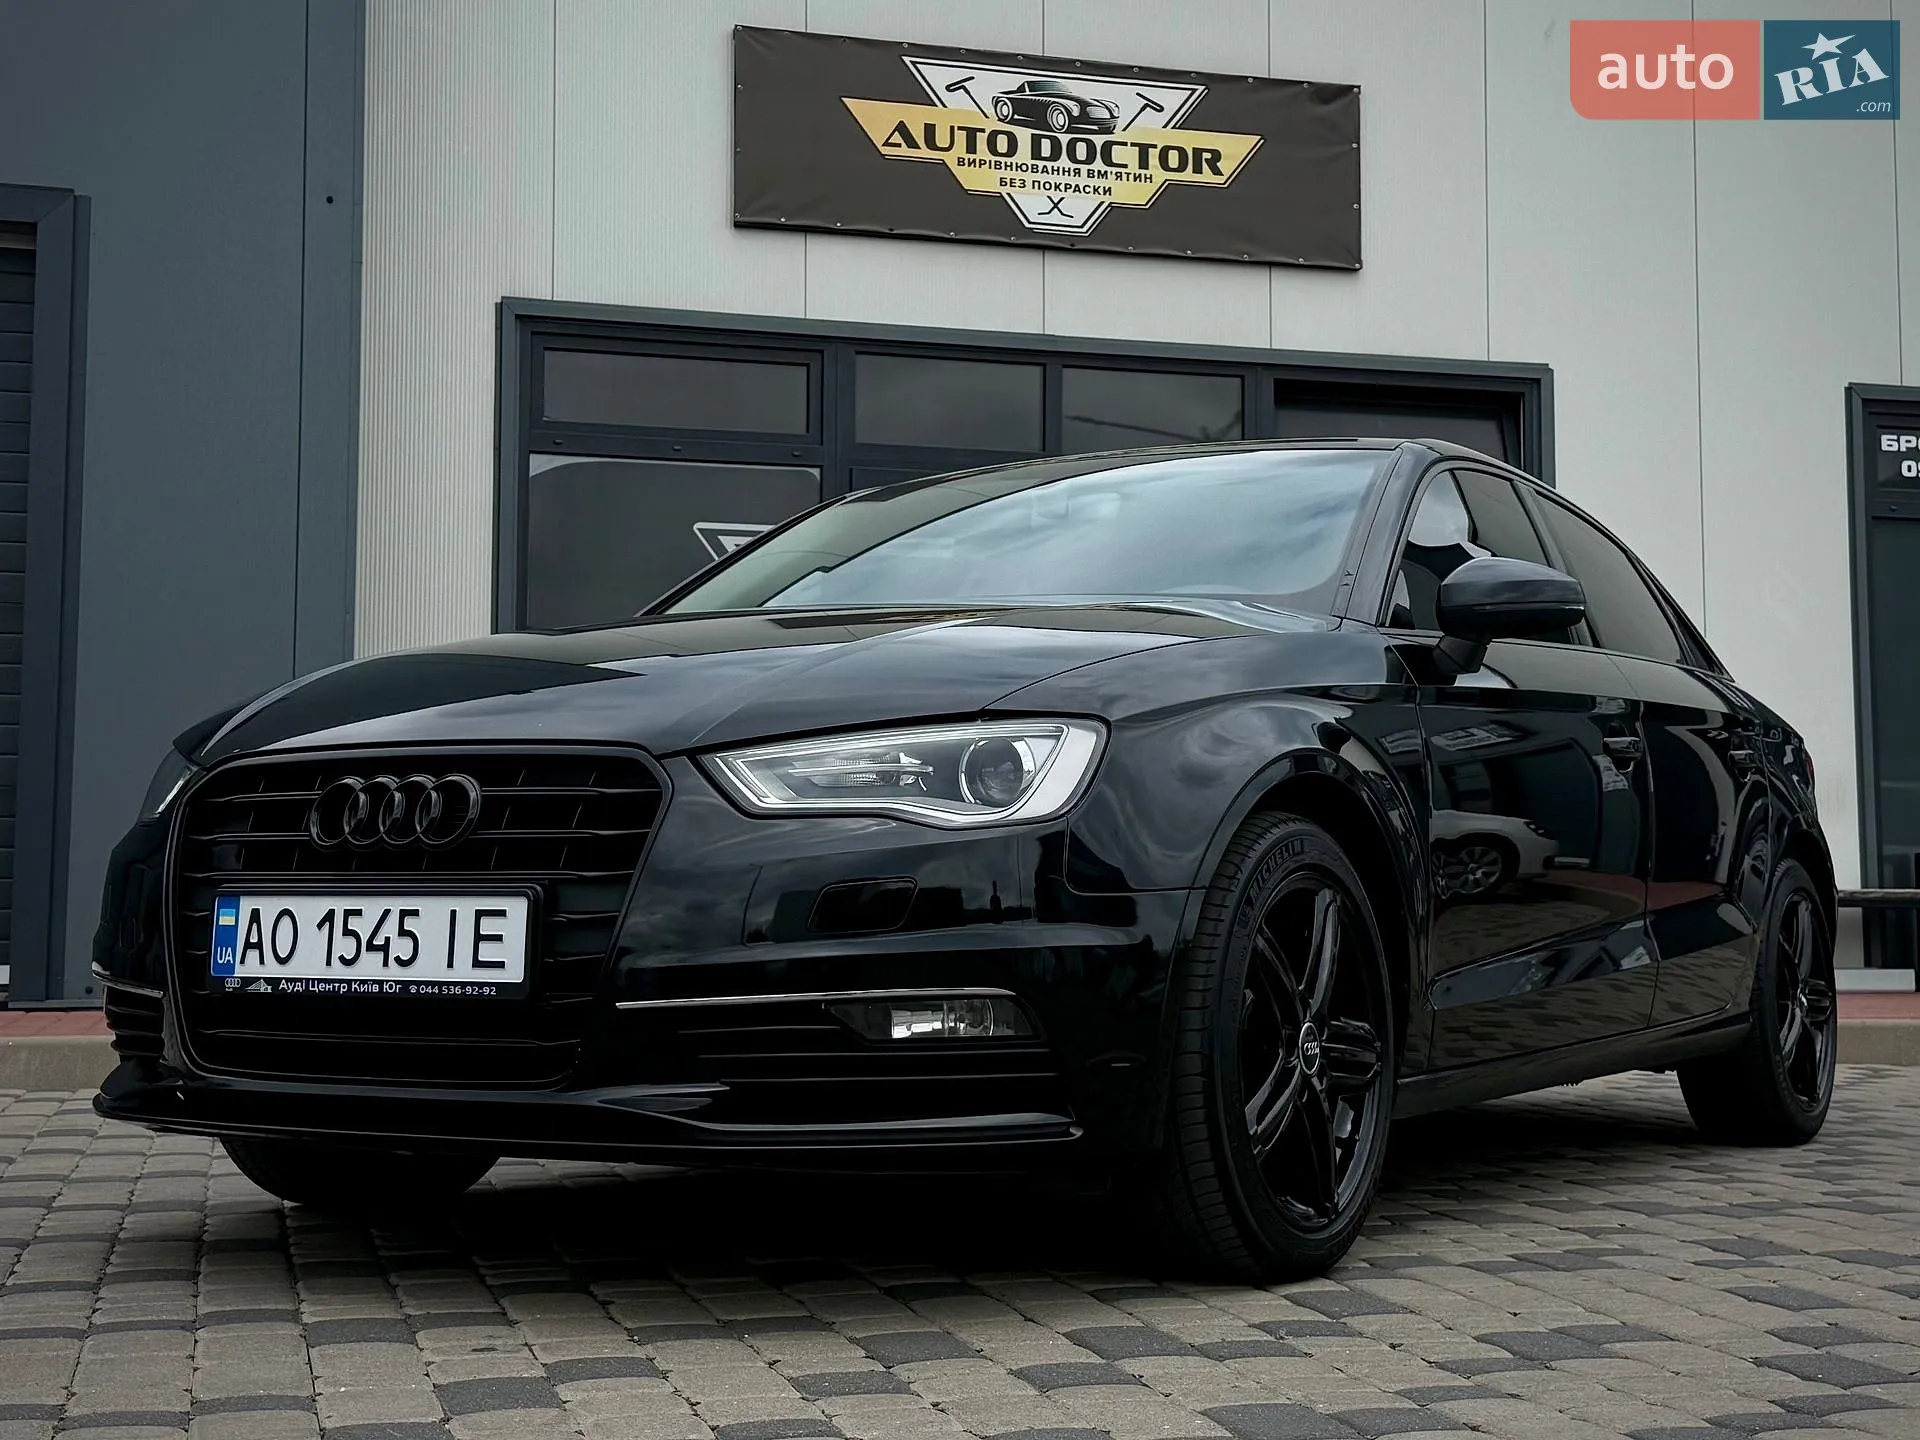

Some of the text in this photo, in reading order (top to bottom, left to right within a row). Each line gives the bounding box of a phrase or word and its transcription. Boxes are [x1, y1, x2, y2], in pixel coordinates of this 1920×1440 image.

[881, 120, 1224, 176] AUTO DOCTOR
[957, 157, 1082, 178] ВИРІВНЮВАННЯ
[999, 177, 1112, 196] БЕЗ ПОКРАСКИ
[316, 908, 421, 968] 1545
[216, 947, 233, 964] UA
[279, 979, 497, 995] Ауді Центр Київ Юг 044 536-92-92
